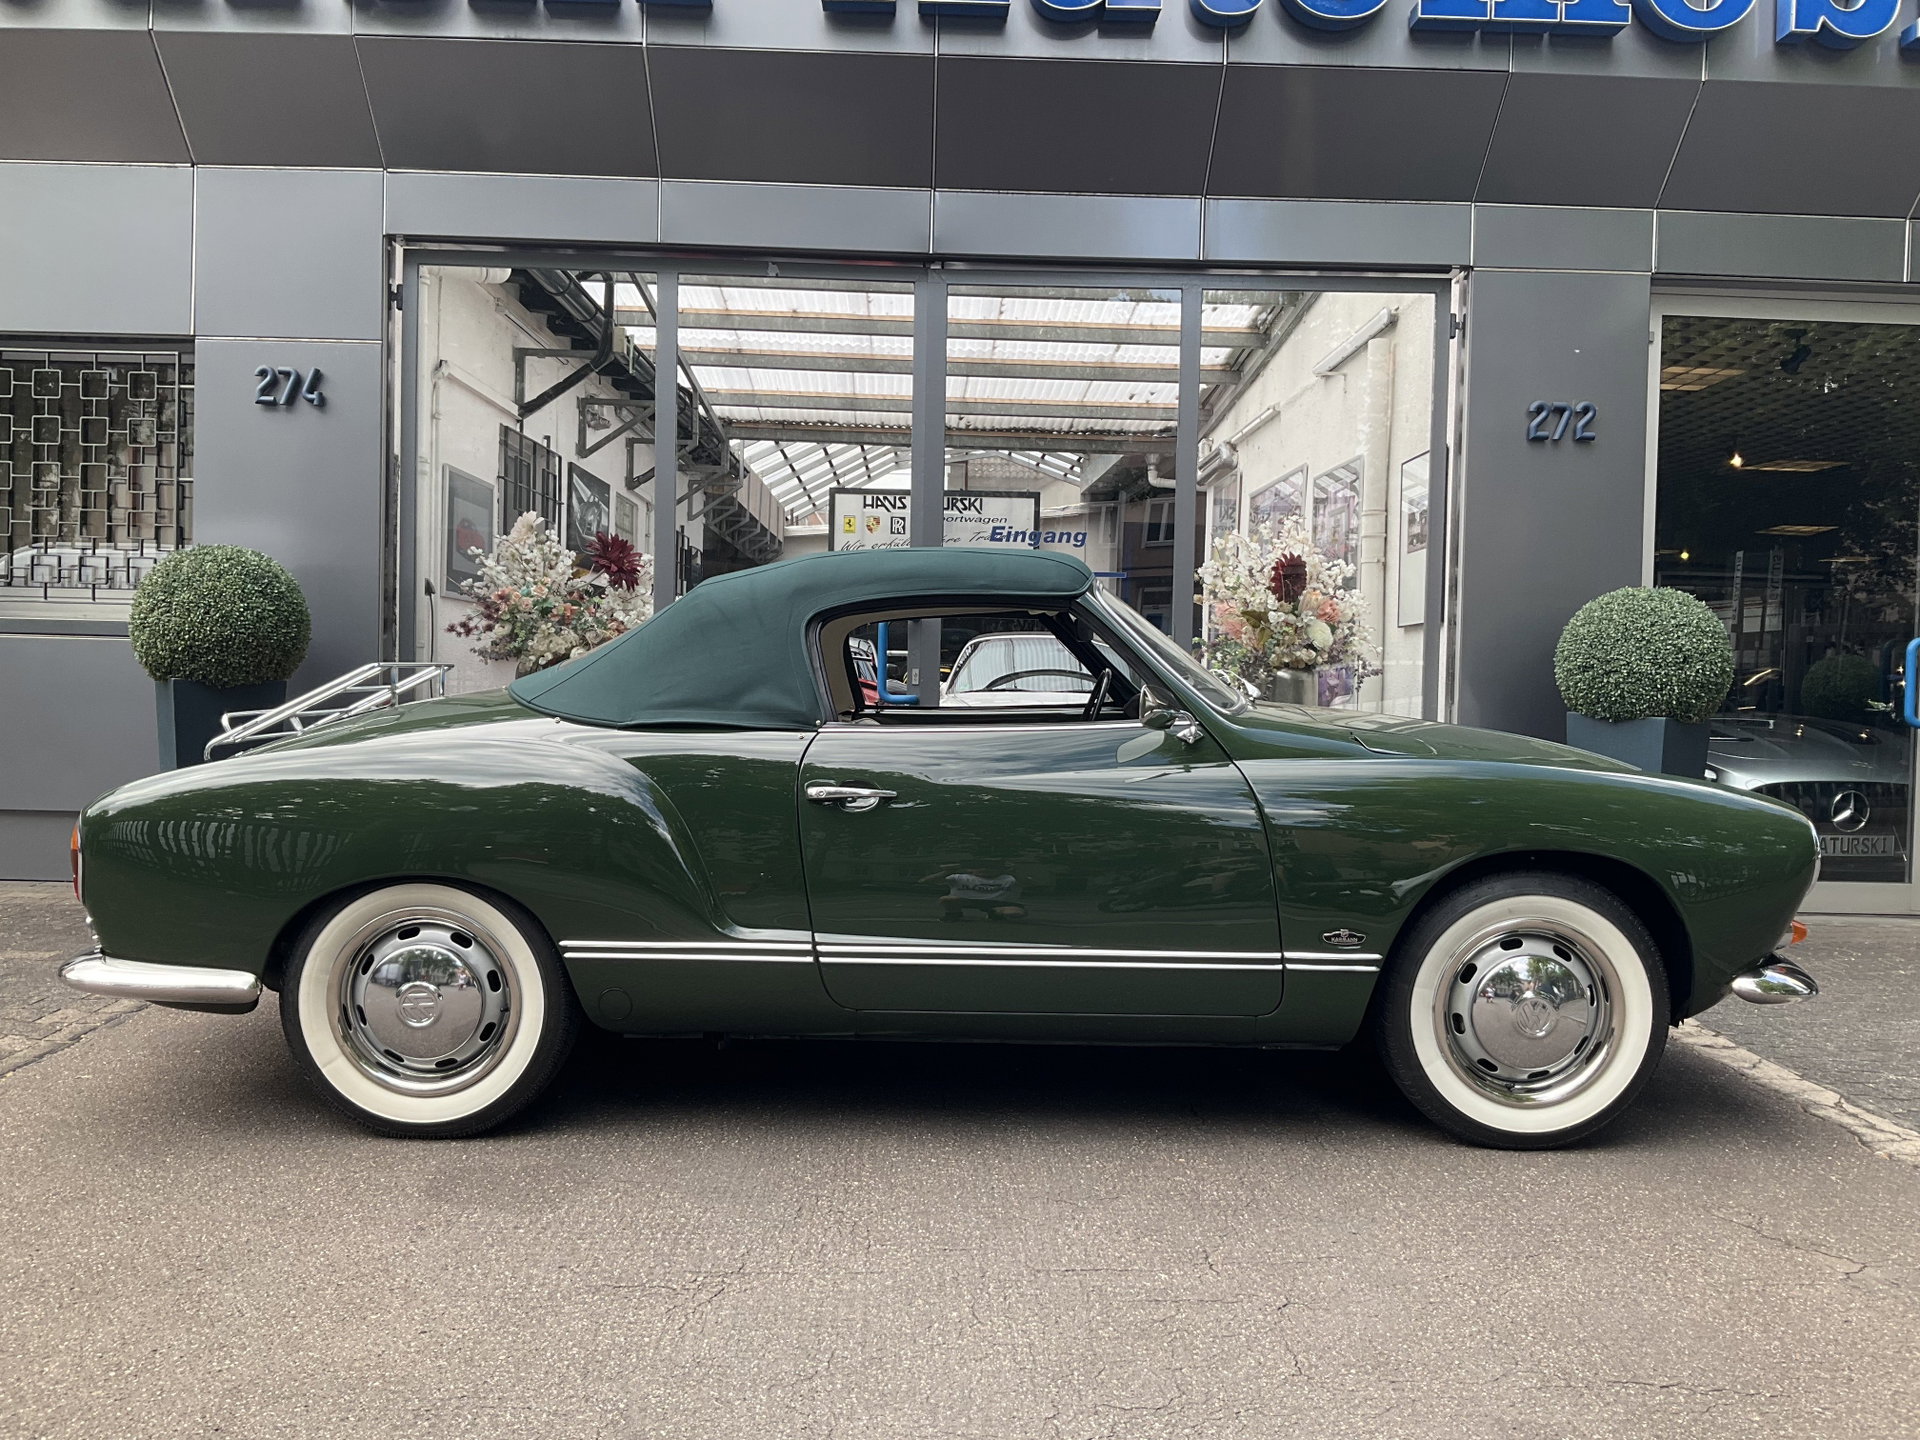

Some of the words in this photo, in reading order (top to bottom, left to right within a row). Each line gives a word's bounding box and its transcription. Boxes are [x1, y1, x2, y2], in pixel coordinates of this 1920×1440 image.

[255, 365, 325, 406] 274
[1528, 401, 1597, 440] 272
[863, 495, 908, 513] HANS
[944, 515, 1008, 525] ortwagen
[871, 537, 911, 550] erfüll
[989, 526, 1088, 548] Eingang
[1819, 838, 1888, 854] ATURSKI
